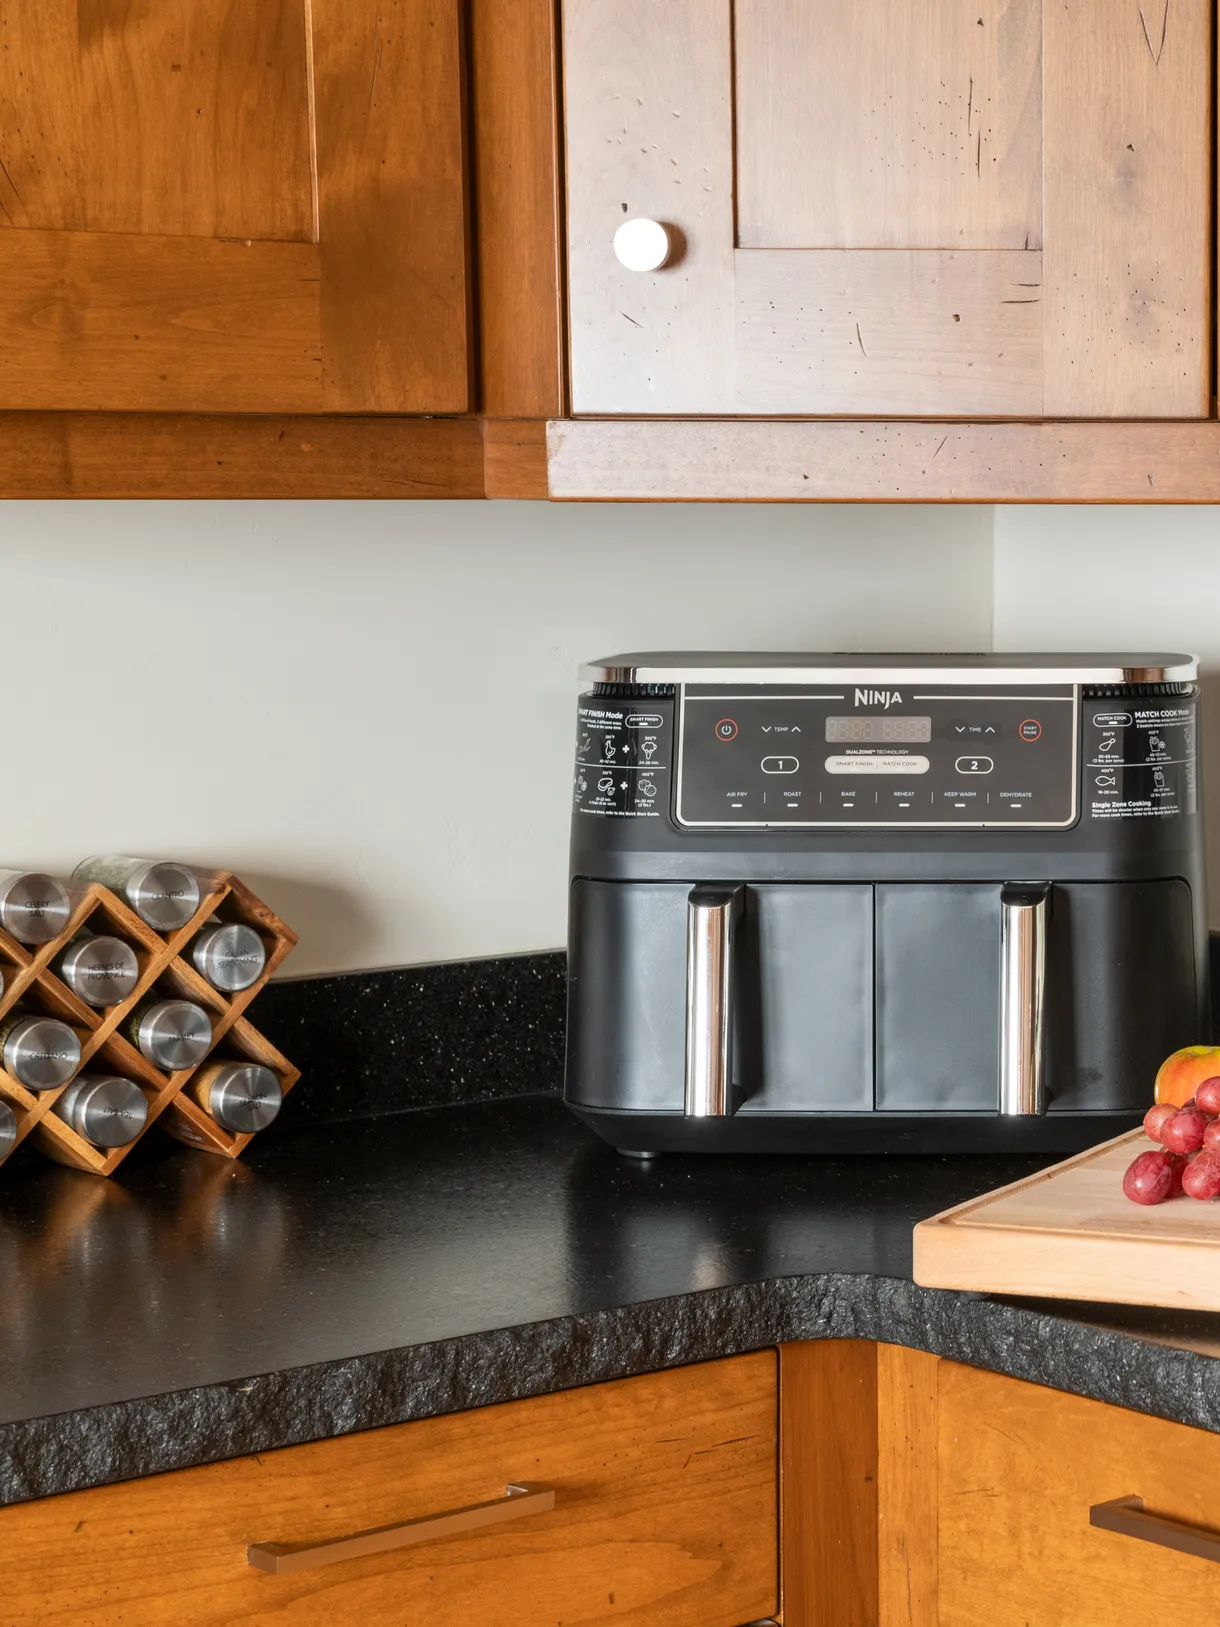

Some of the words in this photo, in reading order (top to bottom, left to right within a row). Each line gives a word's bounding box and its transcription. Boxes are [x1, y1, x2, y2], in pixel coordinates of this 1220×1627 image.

[854, 688, 903, 710] NINJA
[588, 710, 605, 718] FINISH
[605, 711, 624, 720] Mode
[1134, 711, 1160, 719] MATCH
[1160, 709, 1178, 718] COOK
[778, 760, 783, 770] 1
[970, 761, 979, 770] 2
[1127, 800, 1152, 808] Cooking
[24, 901, 49, 909] CELERY
[28, 910, 45, 918] SALT
[224, 949, 250, 959] ITALIAN
[88, 962, 113, 971] HERBES
[115, 961, 125, 970] DE
[217, 956, 258, 969] SEASONING
[87, 971, 126, 981] PROVENCE
[168, 1032, 195, 1043] PARSLEY
[30, 1052, 68, 1060] OREGANO
